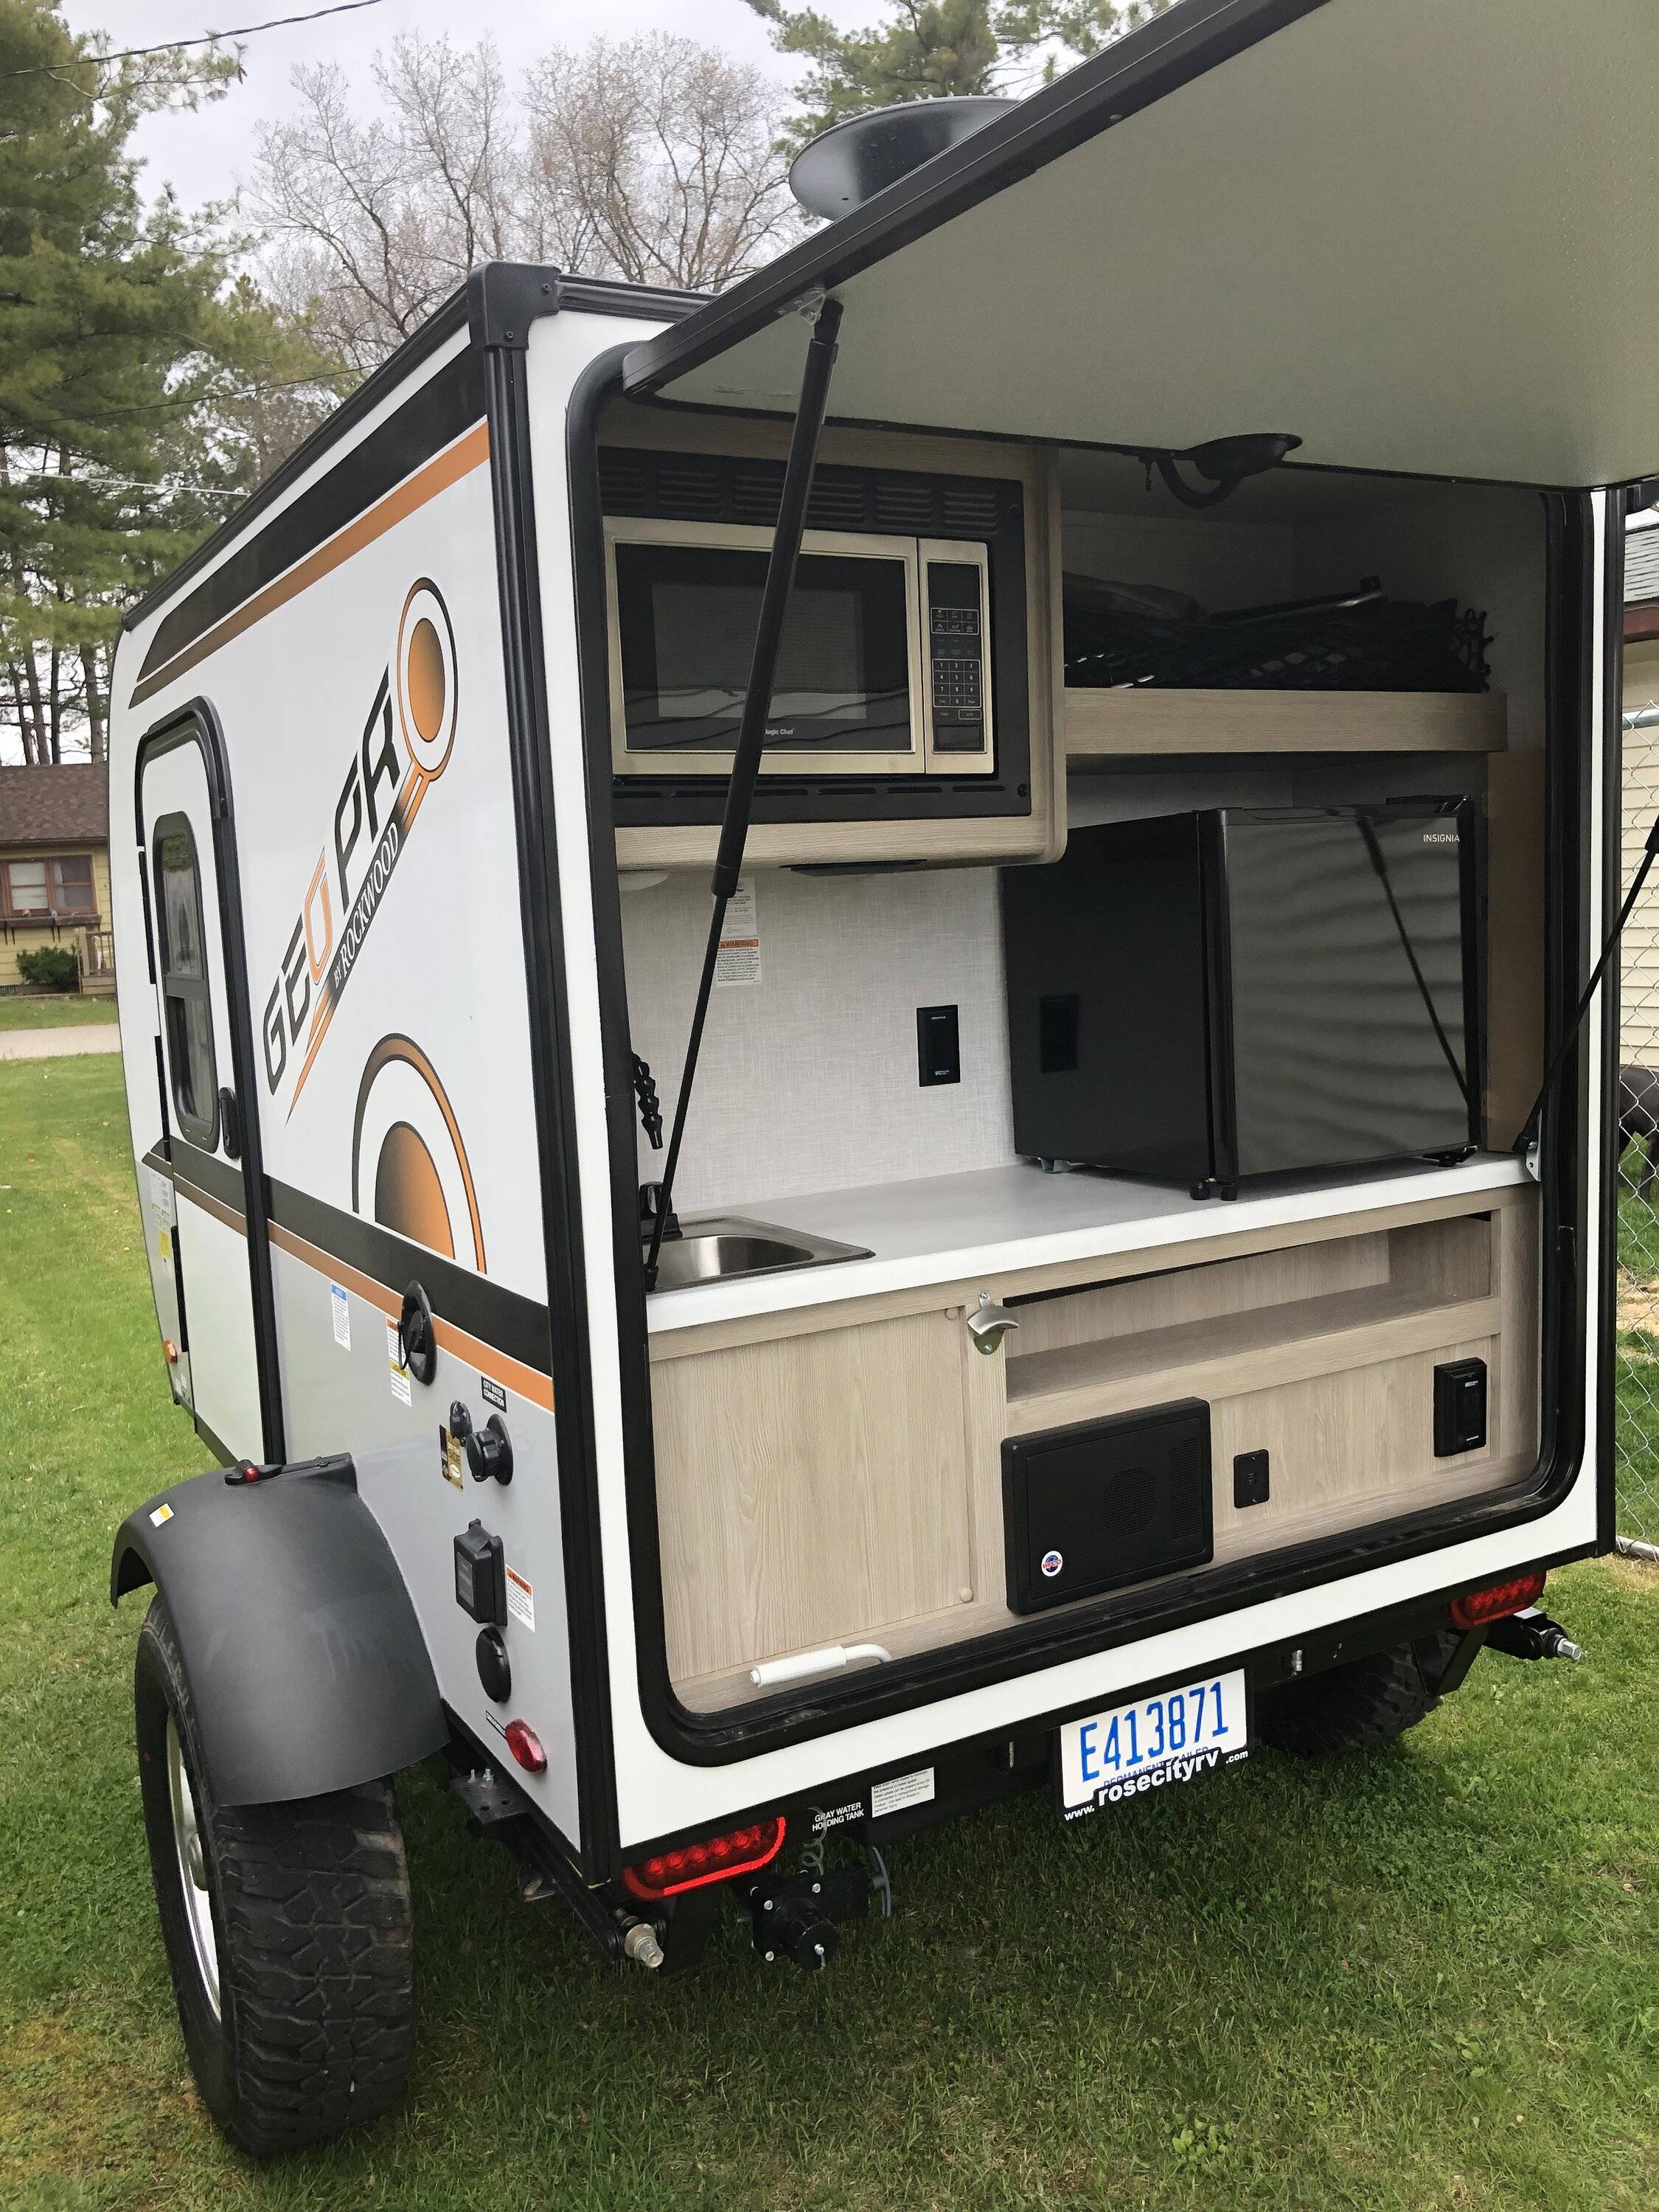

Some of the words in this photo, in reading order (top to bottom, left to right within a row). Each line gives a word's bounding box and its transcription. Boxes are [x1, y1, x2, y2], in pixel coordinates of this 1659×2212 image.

[1423, 833, 1461, 843] INSIGNIA
[334, 961, 343, 989] BY
[340, 822, 399, 975] ROCKWOOD
[1079, 1681, 1228, 1783] E413871
[836, 1802, 861, 1816] WATER
[1064, 1805, 1095, 1822] www.
[1098, 1750, 1219, 1806] rosecityrv
[1225, 1750, 1248, 1764] .com
[812, 1815, 844, 1832] HODING
[845, 1809, 865, 1821] TANK
